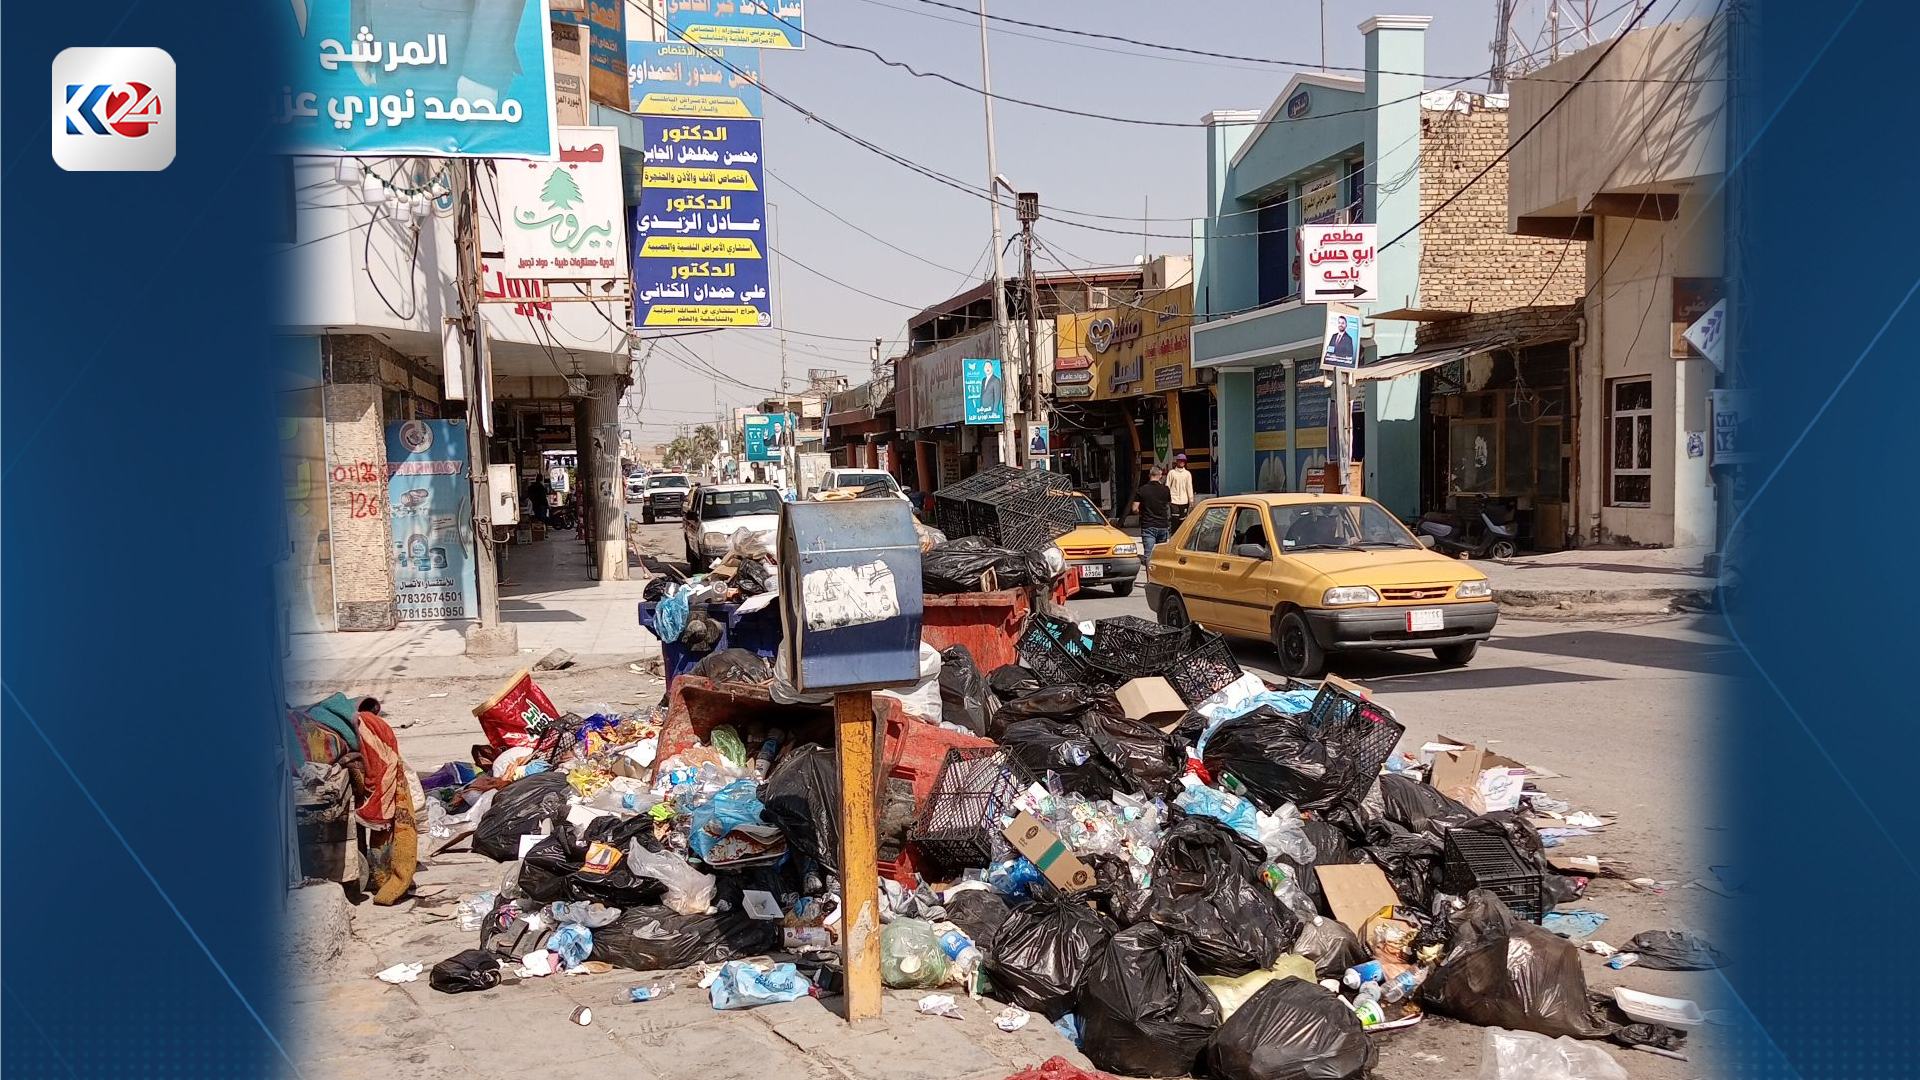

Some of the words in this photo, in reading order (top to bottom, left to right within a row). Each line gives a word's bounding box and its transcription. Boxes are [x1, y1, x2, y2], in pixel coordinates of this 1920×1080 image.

[319, 25, 448, 72] المرشح
[327, 88, 416, 130] نوري
[424, 96, 523, 124] محمد
[662, 125, 728, 143] الدكتور
[723, 149, 759, 166] محسن
[666, 194, 732, 212] الدكتور
[513, 205, 612, 253] بيروت
[1319, 229, 1364, 247] مطعم
[535, 257, 548, 268] مواد
[1309, 246, 1349, 265] حسن
[1352, 246, 1374, 266] ابو
[670, 261, 735, 280] الدكتور
[640, 282, 690, 305] الكناني
[693, 283, 735, 302] حمدان
[739, 284, 767, 305] علي
[386, 461, 463, 476] PHARMACY
[350, 491, 378, 518] 126
[395, 591, 463, 604] 07832674501
[397, 606, 465, 619] 07815530950
